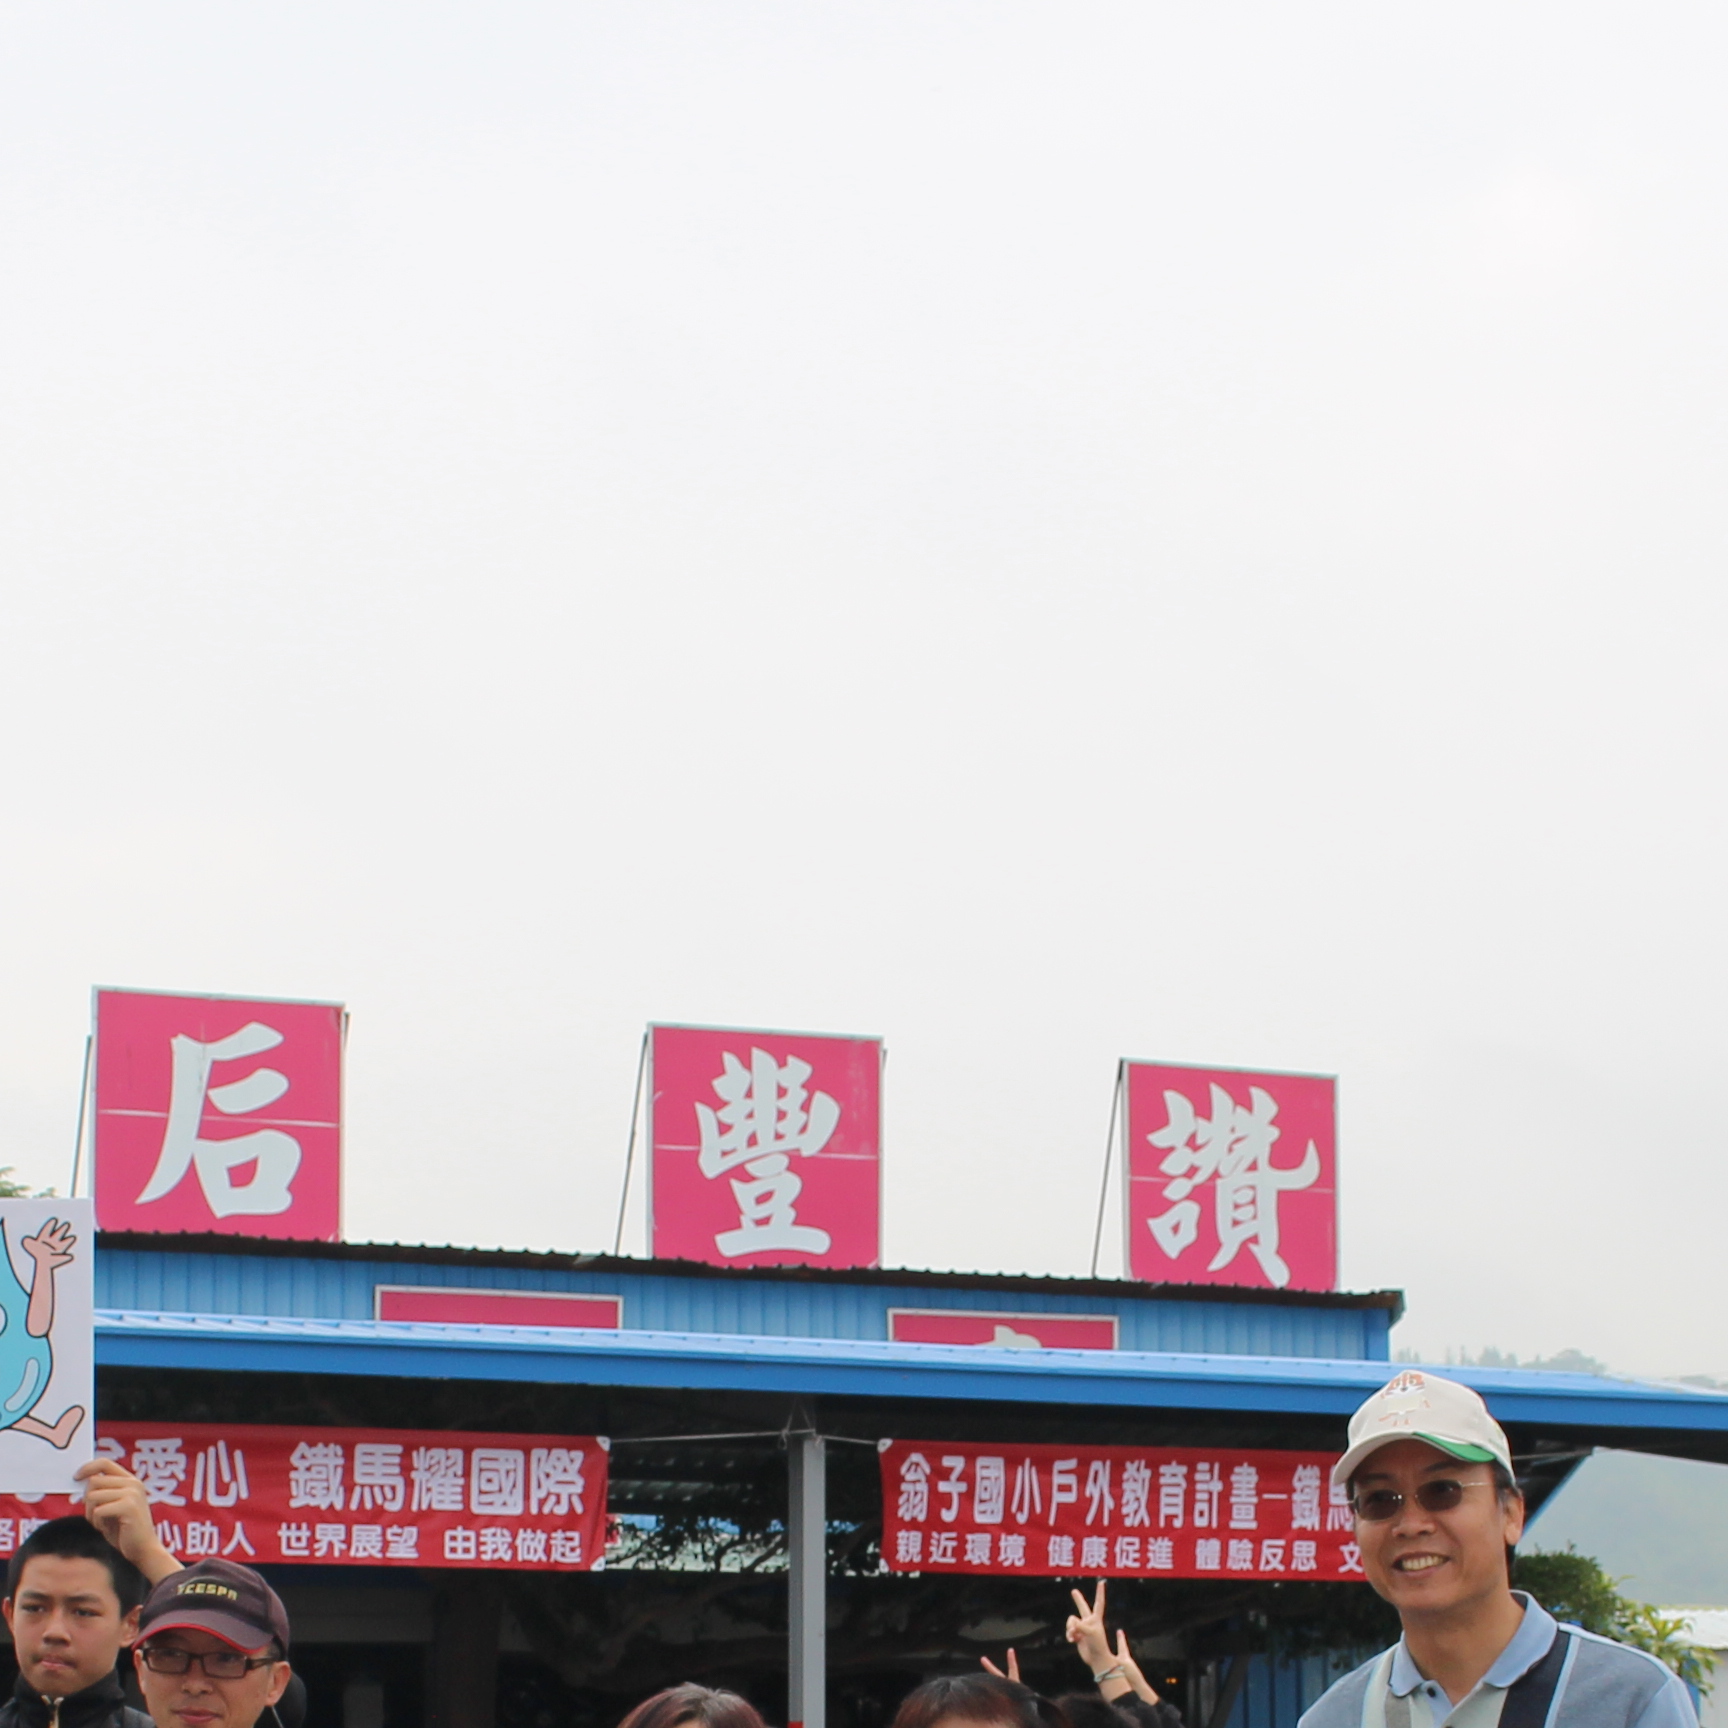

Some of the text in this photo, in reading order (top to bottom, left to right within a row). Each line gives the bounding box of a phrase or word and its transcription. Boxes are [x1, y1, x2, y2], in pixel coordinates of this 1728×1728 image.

[136, 1021, 1320, 1287] 后 豐 讚
[288, 1441, 585, 1516] 鐵馬耀國際
[277, 1522, 419, 1559] 世界展望
[444, 1526, 582, 1564] 由我做起
[895, 1529, 1026, 1568] 親近環境
[1048, 1534, 1174, 1571] 健康促進
[1195, 1537, 1318, 1573] 體驗反思
